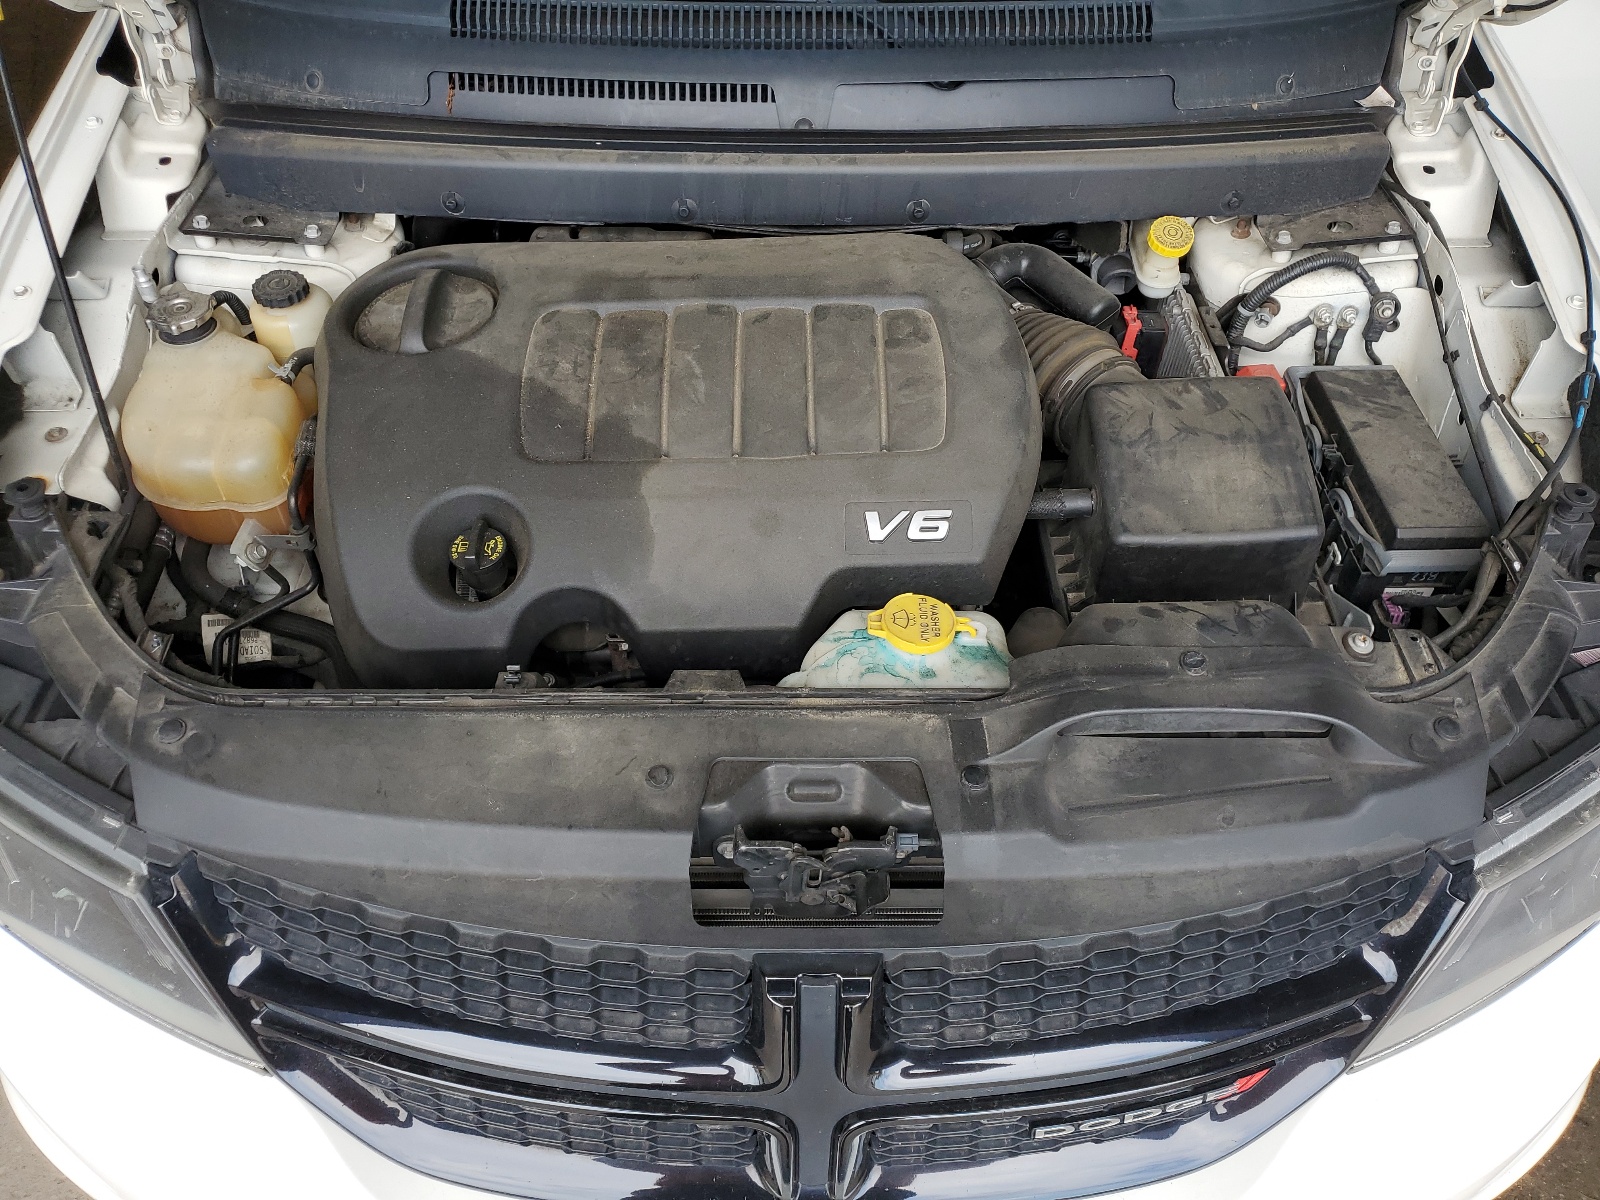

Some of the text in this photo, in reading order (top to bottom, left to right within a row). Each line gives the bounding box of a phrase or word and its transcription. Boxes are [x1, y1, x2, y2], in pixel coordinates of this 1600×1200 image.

[863, 509, 953, 544] V6
[918, 597, 930, 643] FLUID ONLY
[929, 603, 941, 639] WASHER
[1033, 1087, 1235, 1139] DODGE
